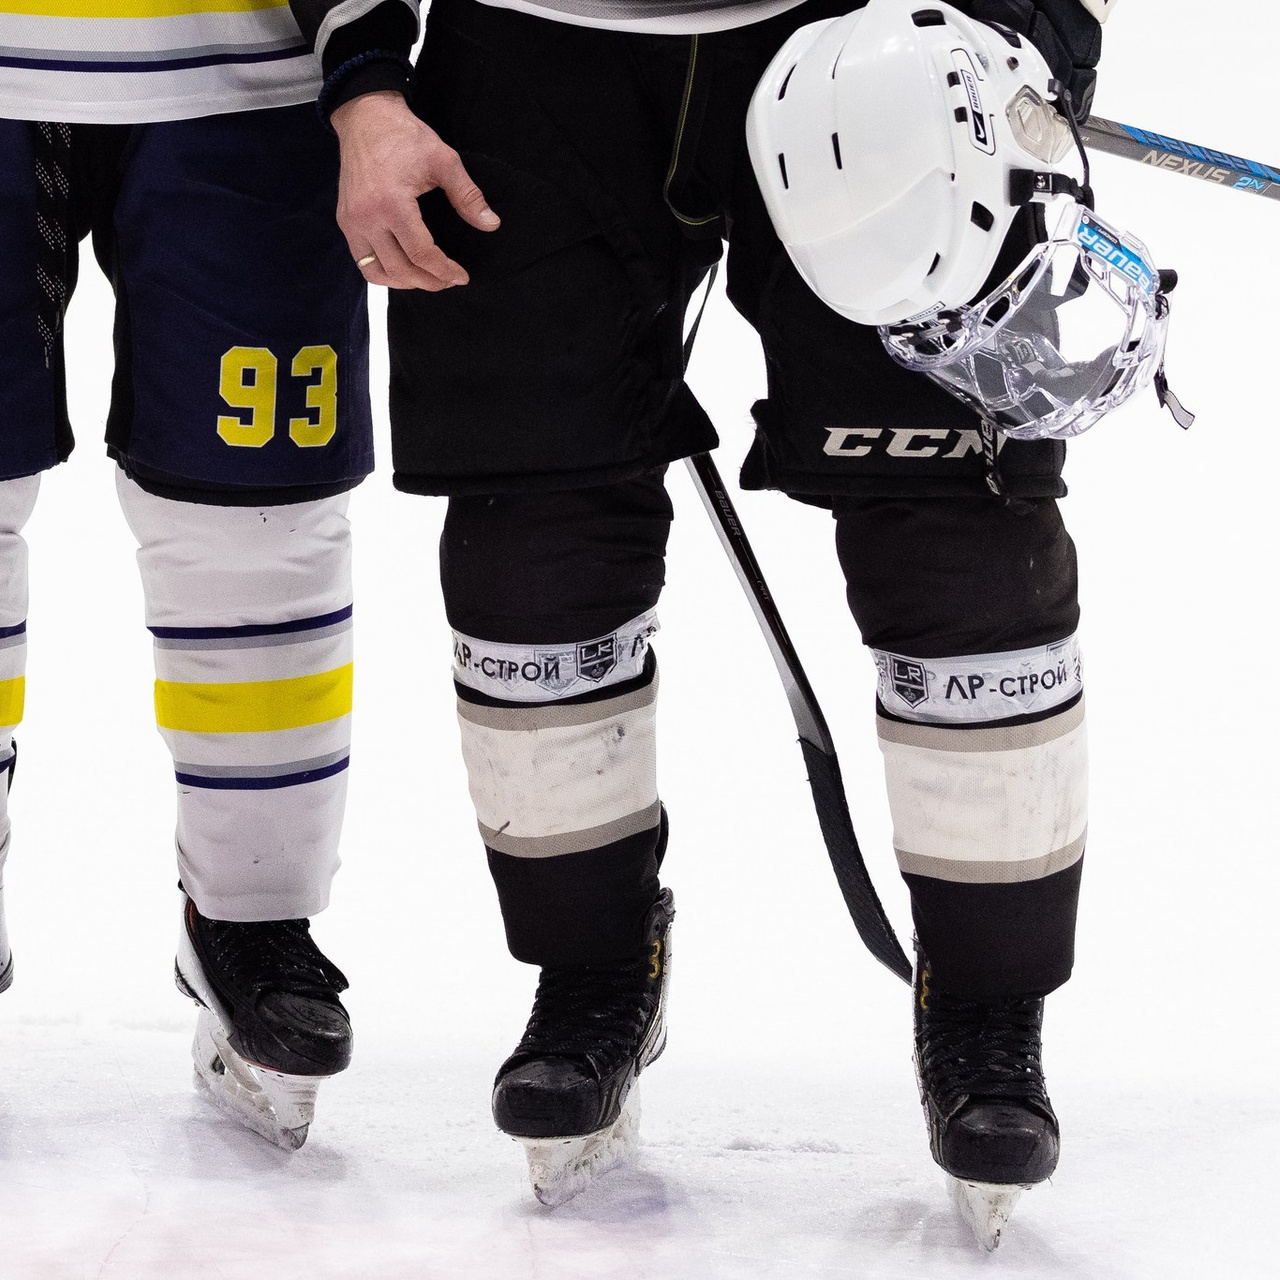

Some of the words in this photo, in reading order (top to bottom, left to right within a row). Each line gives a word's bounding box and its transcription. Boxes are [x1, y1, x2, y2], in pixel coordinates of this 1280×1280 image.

[1142, 150, 1230, 183] NEXUS
[217, 345, 338, 448] 93
[582, 641, 613, 661] LR
[894, 662, 922, 684] LR
